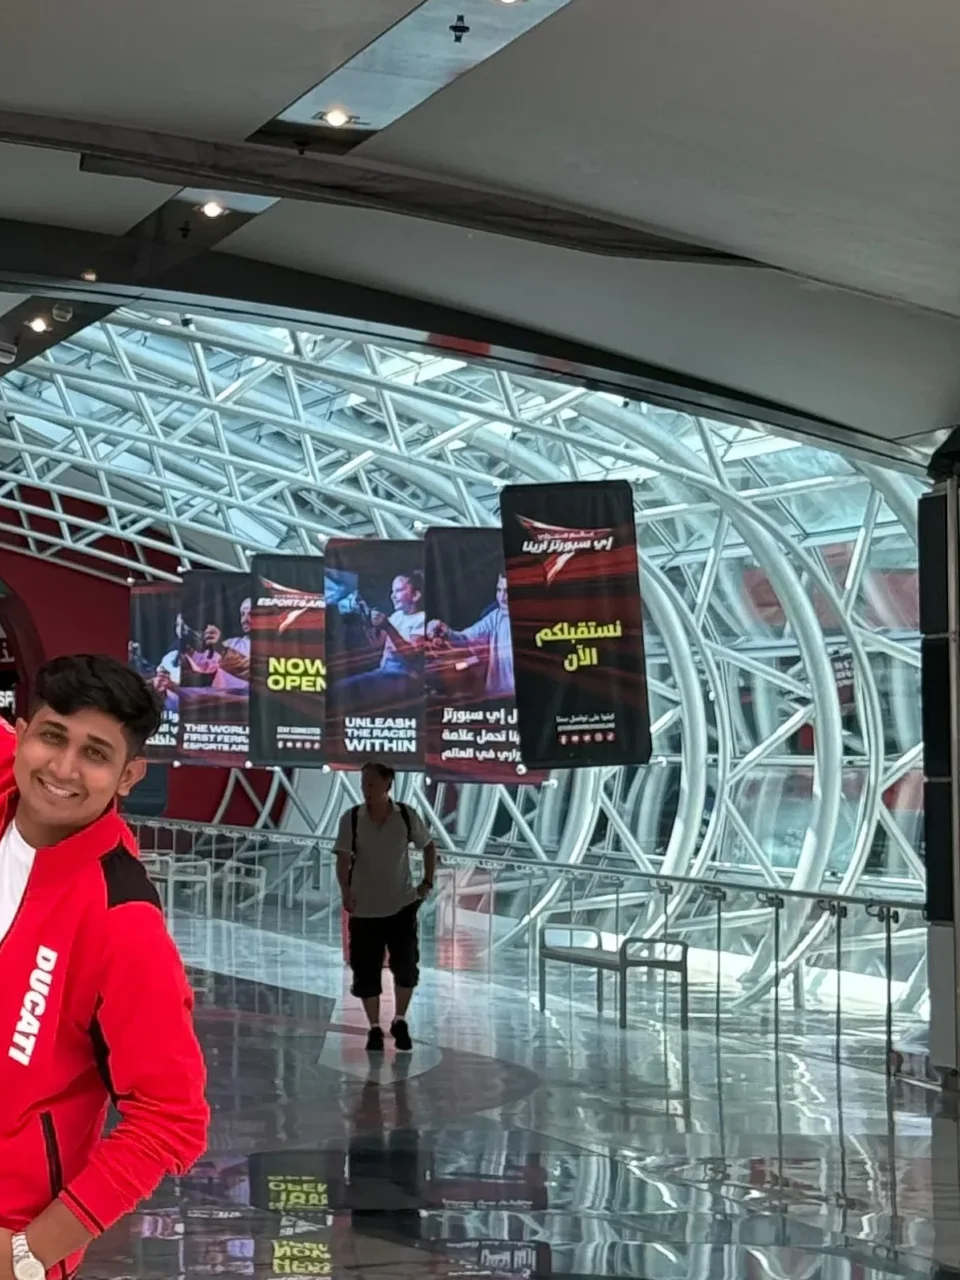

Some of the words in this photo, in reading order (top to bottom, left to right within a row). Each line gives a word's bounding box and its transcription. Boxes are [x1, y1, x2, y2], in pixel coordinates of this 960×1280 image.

[535, 620, 623, 648] نستقبلكم
[268, 657, 327, 675] NOW
[563, 645, 598, 672] الآن
[267, 675, 327, 692] OPEN
[184, 723, 208, 733] THE
[344, 716, 417, 728] UNLEASH
[344, 728, 371, 738] THE
[372, 728, 417, 738] RACER
[344, 738, 417, 752] WITHIN
[7, 944, 59, 1067] DUCATI
